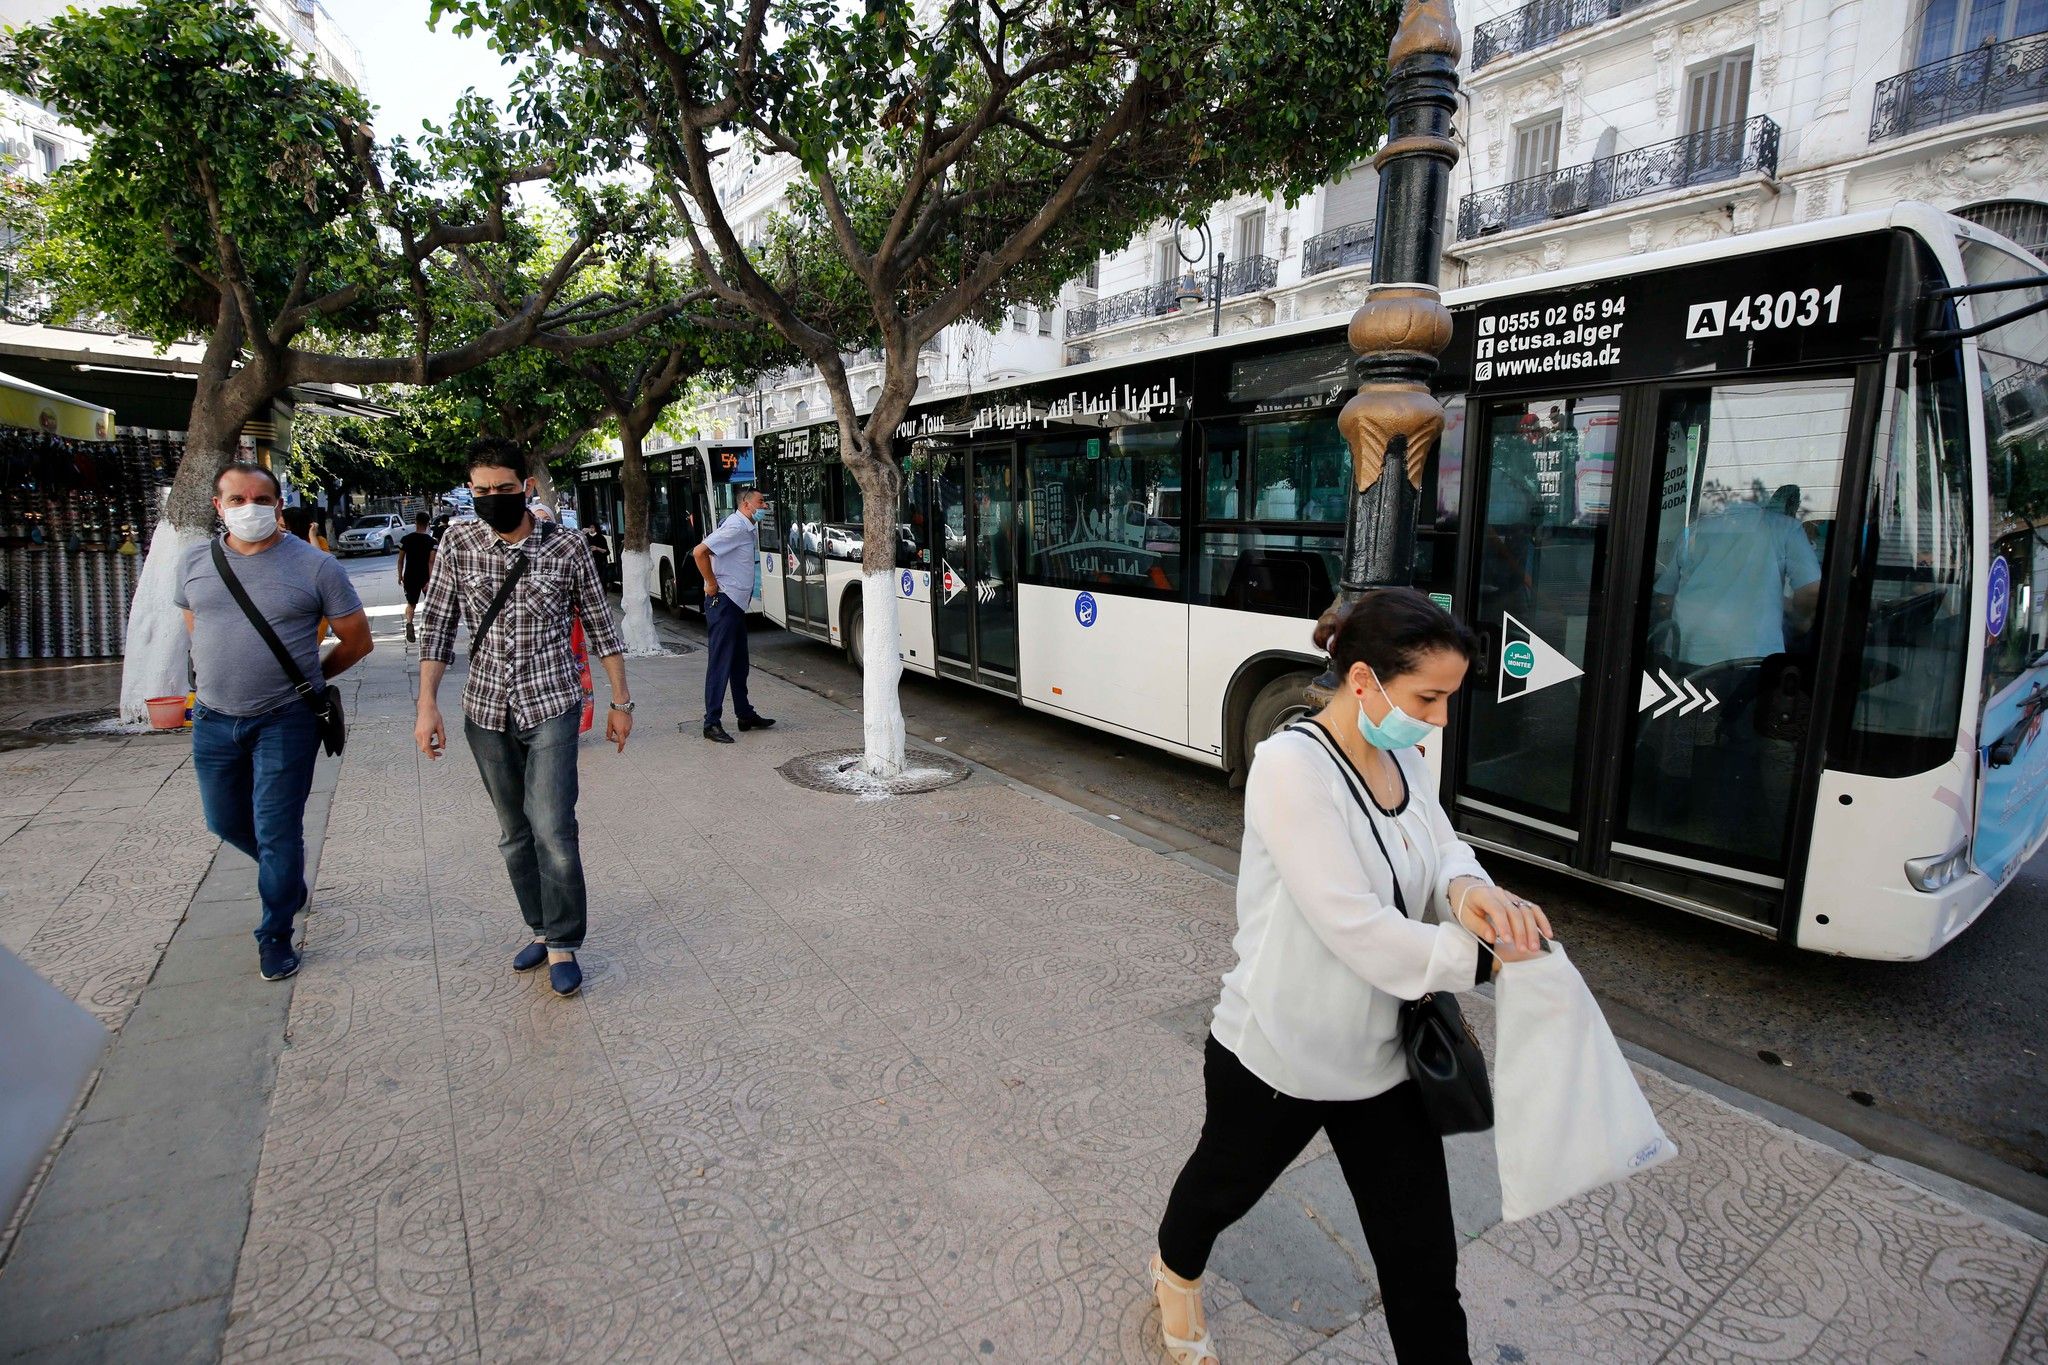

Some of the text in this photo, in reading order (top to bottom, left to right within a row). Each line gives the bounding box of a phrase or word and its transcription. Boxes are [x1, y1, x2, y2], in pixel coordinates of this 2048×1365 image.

[1498, 296, 1626, 334] 0555 02 65 94
[1729, 285, 1842, 331] 43031
[1497, 322, 1624, 354] etusa.alger
[1496, 343, 1621, 378] www.etusa.dz
[921, 413, 944, 436] Tous
[720, 453, 738, 469] 54
